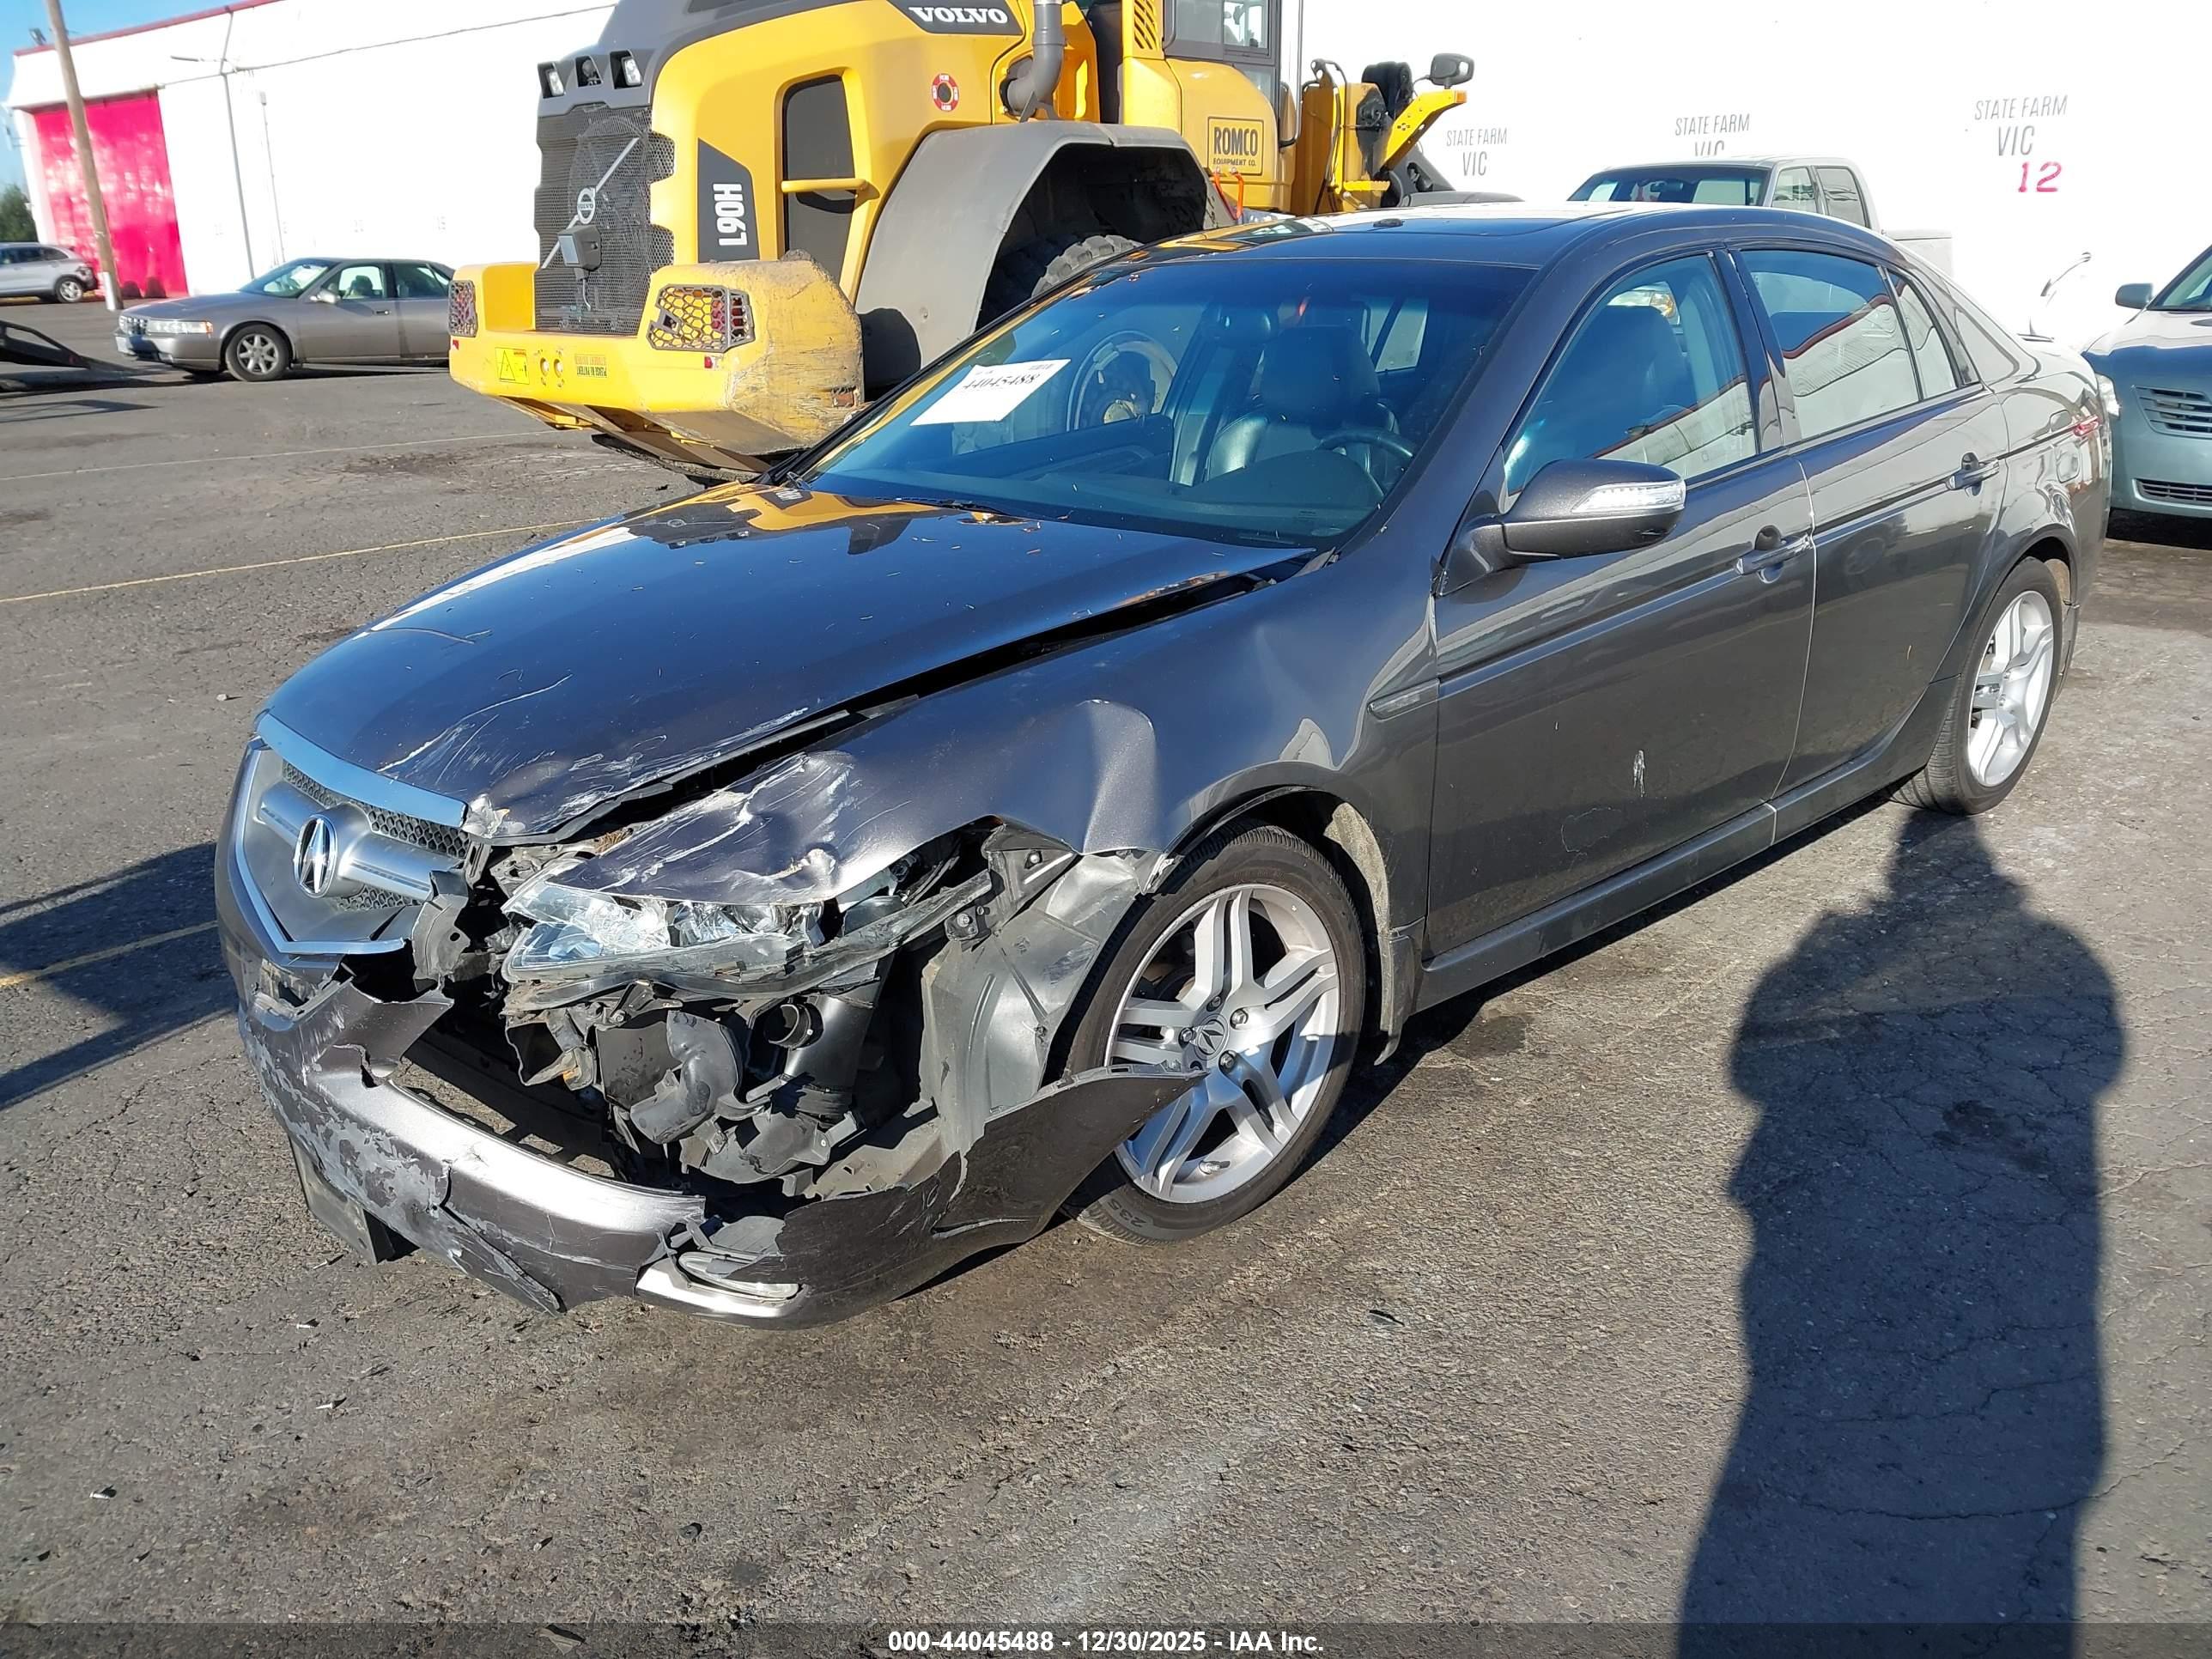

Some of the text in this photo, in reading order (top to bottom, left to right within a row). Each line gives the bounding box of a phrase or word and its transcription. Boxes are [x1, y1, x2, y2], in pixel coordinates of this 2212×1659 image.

[908, 7, 1008, 24] VOLVO
[1974, 94, 2068, 120] STATE FARM
[1446, 126, 1508, 147] STATE FARM
[1674, 112, 1751, 137] STATE FARM
[1213, 126, 1259, 156] ROMCO
[1998, 125, 2035, 156] VIC
[1212, 157, 1247, 166] EQUIPMENT
[1462, 150, 1487, 177] VIC
[2018, 161, 2062, 193] 12
[713, 183, 748, 246] L90H
